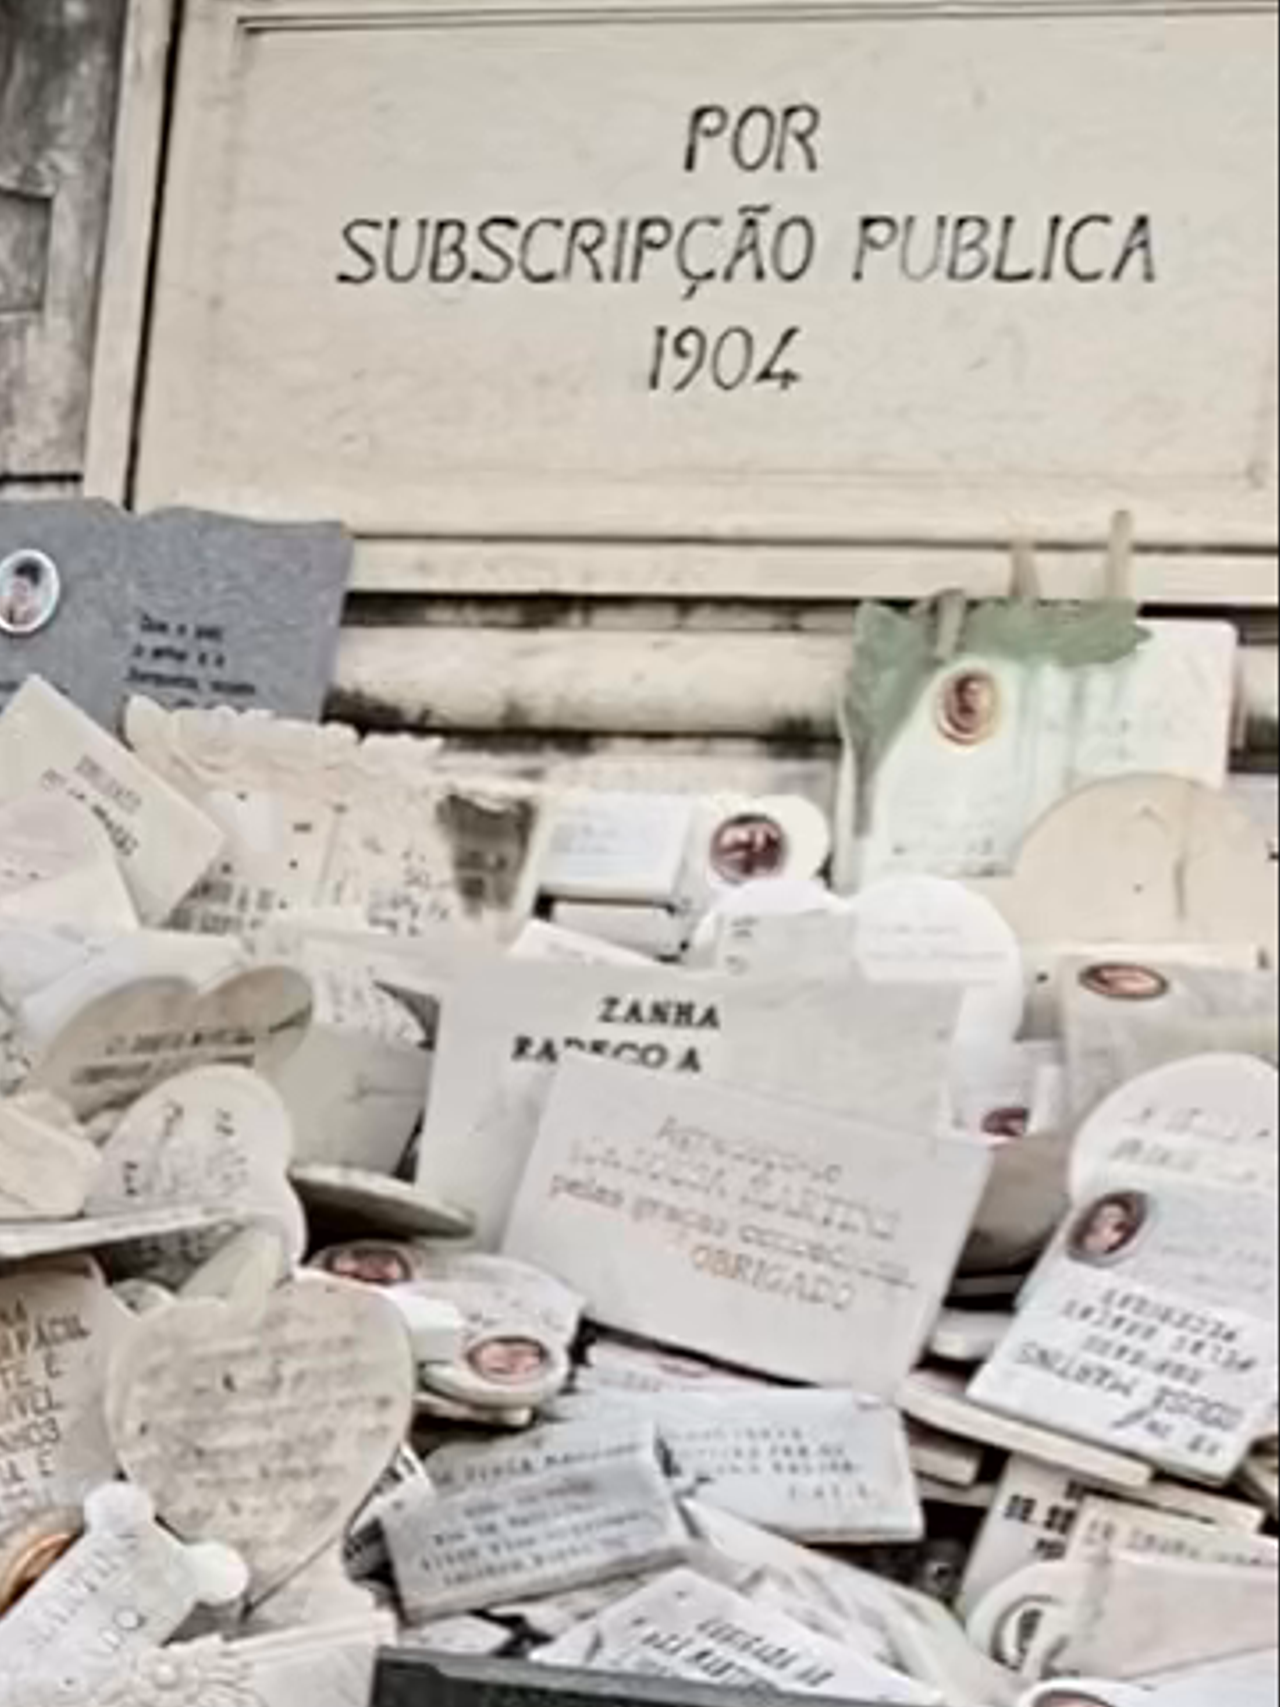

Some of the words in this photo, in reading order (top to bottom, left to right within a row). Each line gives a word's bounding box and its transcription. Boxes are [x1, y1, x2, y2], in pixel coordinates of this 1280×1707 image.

[683, 104, 820, 172] POR
[336, 205, 815, 298] SUBSCRIPÇÃO
[851, 214, 1157, 282] PUBLICA
[646, 325, 801, 391] 1904
[598, 995, 721, 1029] ZANHA
